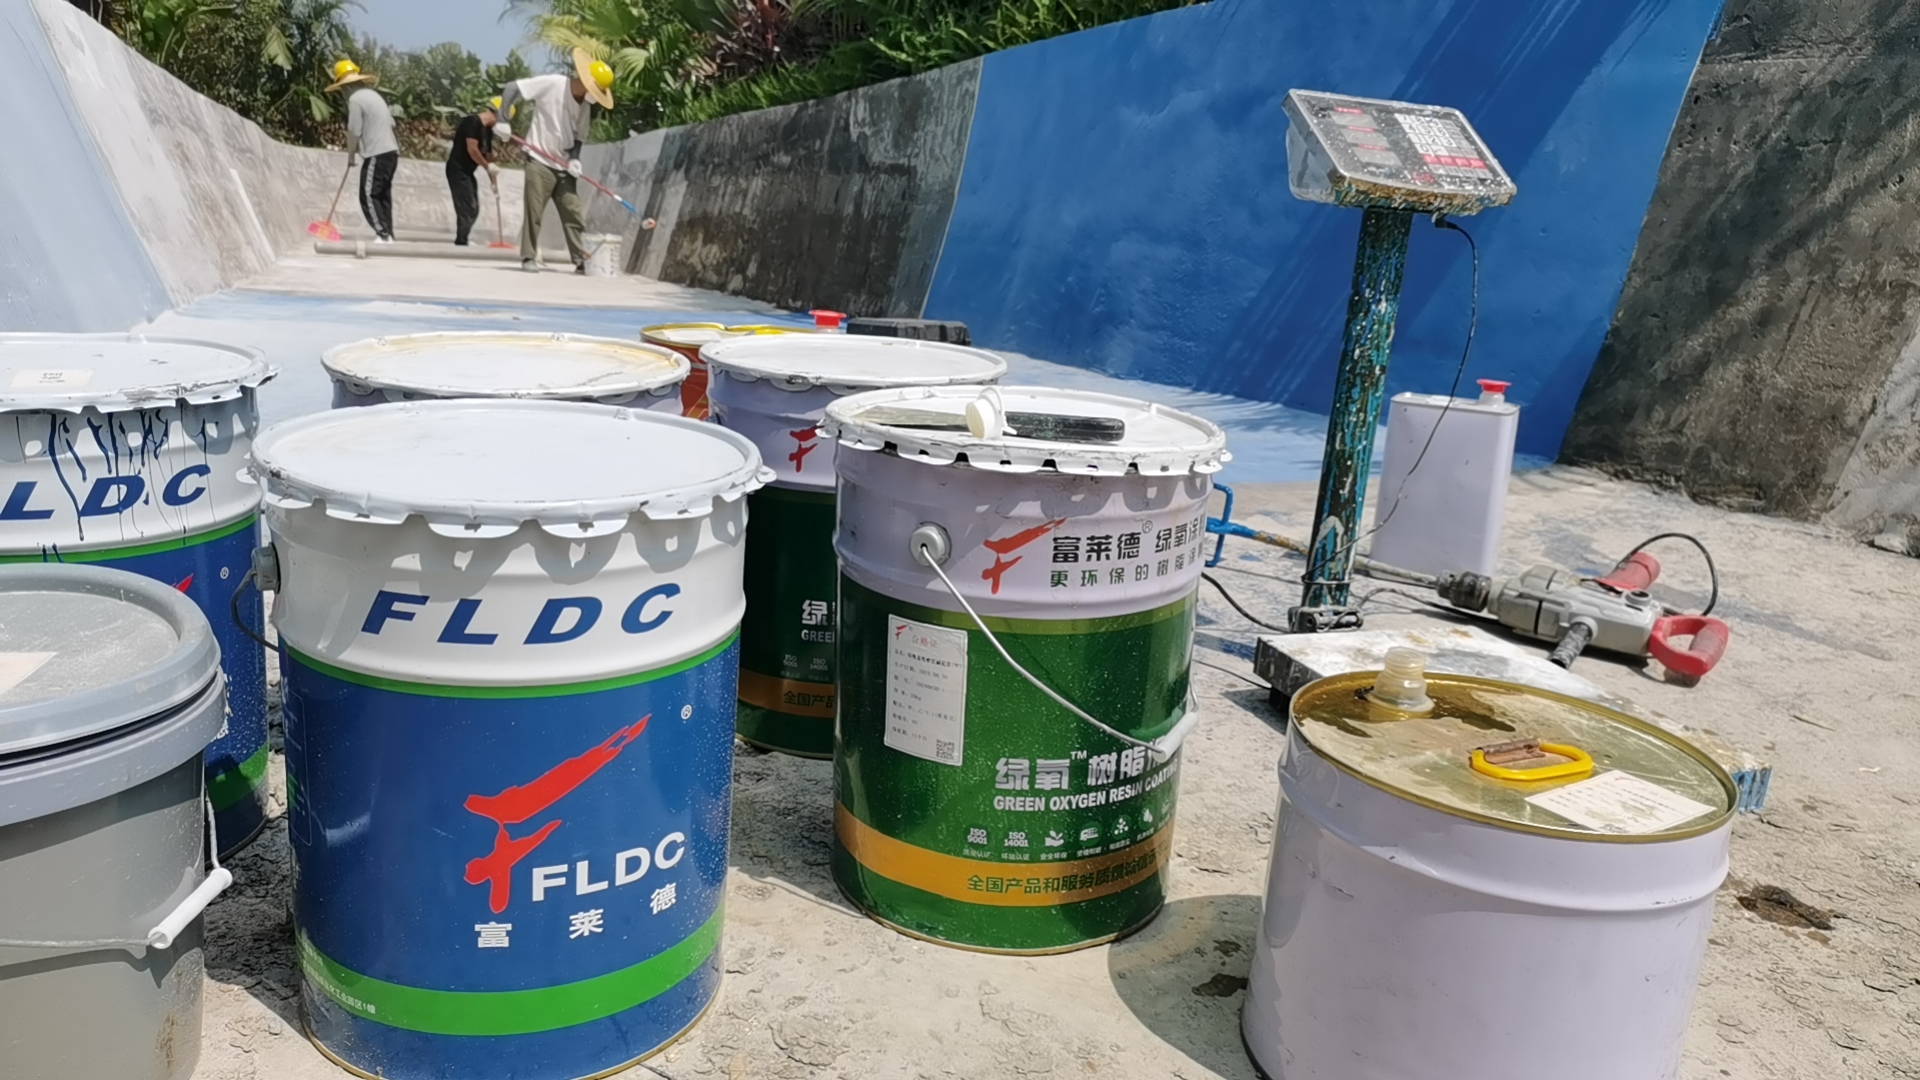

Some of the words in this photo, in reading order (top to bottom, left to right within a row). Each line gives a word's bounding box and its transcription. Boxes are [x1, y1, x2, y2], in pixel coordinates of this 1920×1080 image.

[1052, 532, 1142, 564] 富莱德
[361, 583, 681, 645] FLDC
[802, 599, 835, 626] 绿
[1087, 746, 1160, 787] 树脂
[993, 796, 1045, 812] GREEN
[1050, 791, 1106, 811] OXYGEN
[1109, 782, 1143, 804] RESIN
[967, 834, 988, 845] 9001
[969, 827, 987, 837] ISO
[1004, 838, 1029, 848] 14001
[1008, 831, 1026, 841] ISO
[532, 831, 685, 902] FLDC
[474, 882, 677, 948] 富莱德
